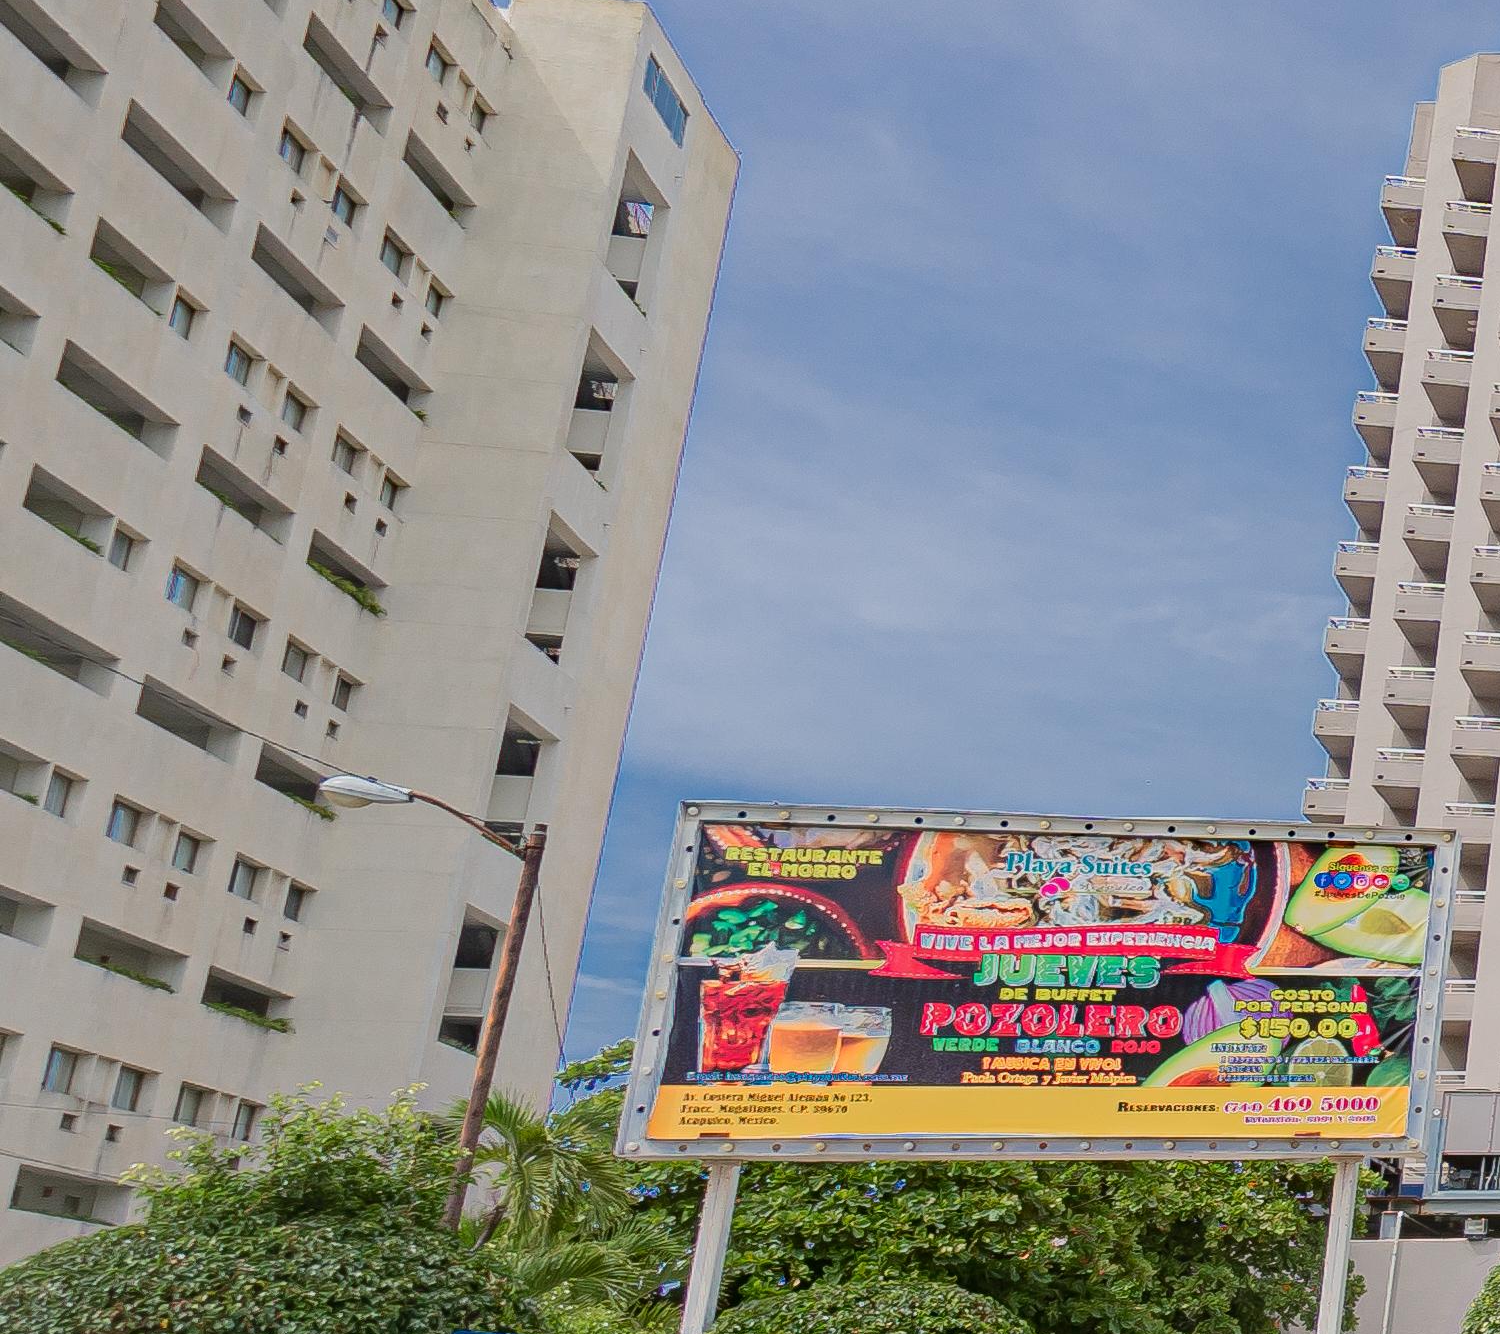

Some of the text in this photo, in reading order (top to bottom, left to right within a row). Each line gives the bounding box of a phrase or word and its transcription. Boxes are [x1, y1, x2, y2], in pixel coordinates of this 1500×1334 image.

[725, 846, 883, 866] RESTAURANTE
[747, 862, 857, 880] EL MORRO
[1006, 850, 1153, 880] Playa Suites
[919, 931, 1217, 952] VIVE LA MEJOR EXPERIENCIA
[973, 953, 1162, 989] JUEVES
[999, 987, 1117, 1002] DE BUFFET
[1270, 988, 1336, 1002] COSTO
[1234, 1000, 1368, 1014] POR PERSONA
[919, 1002, 1184, 1038] POZOLERO
[1239, 1015, 1360, 1039] $150.00
[932, 1038, 1161, 1054] VERDE BLANCO ROJO
[1053, 1057, 1078, 1071] EN
[1079, 1058, 1122, 1071] VIVO!
[960, 1071, 995, 1084] Paola
[998, 1072, 1039, 1085] Ortega
[1041, 1075, 1051, 1085] y
[703, 1092, 744, 1102] Costera
[747, 1092, 786, 1103] Miguel
[1267, 1096, 1313, 1113] 469
[1320, 1096, 1382, 1113] 5000
